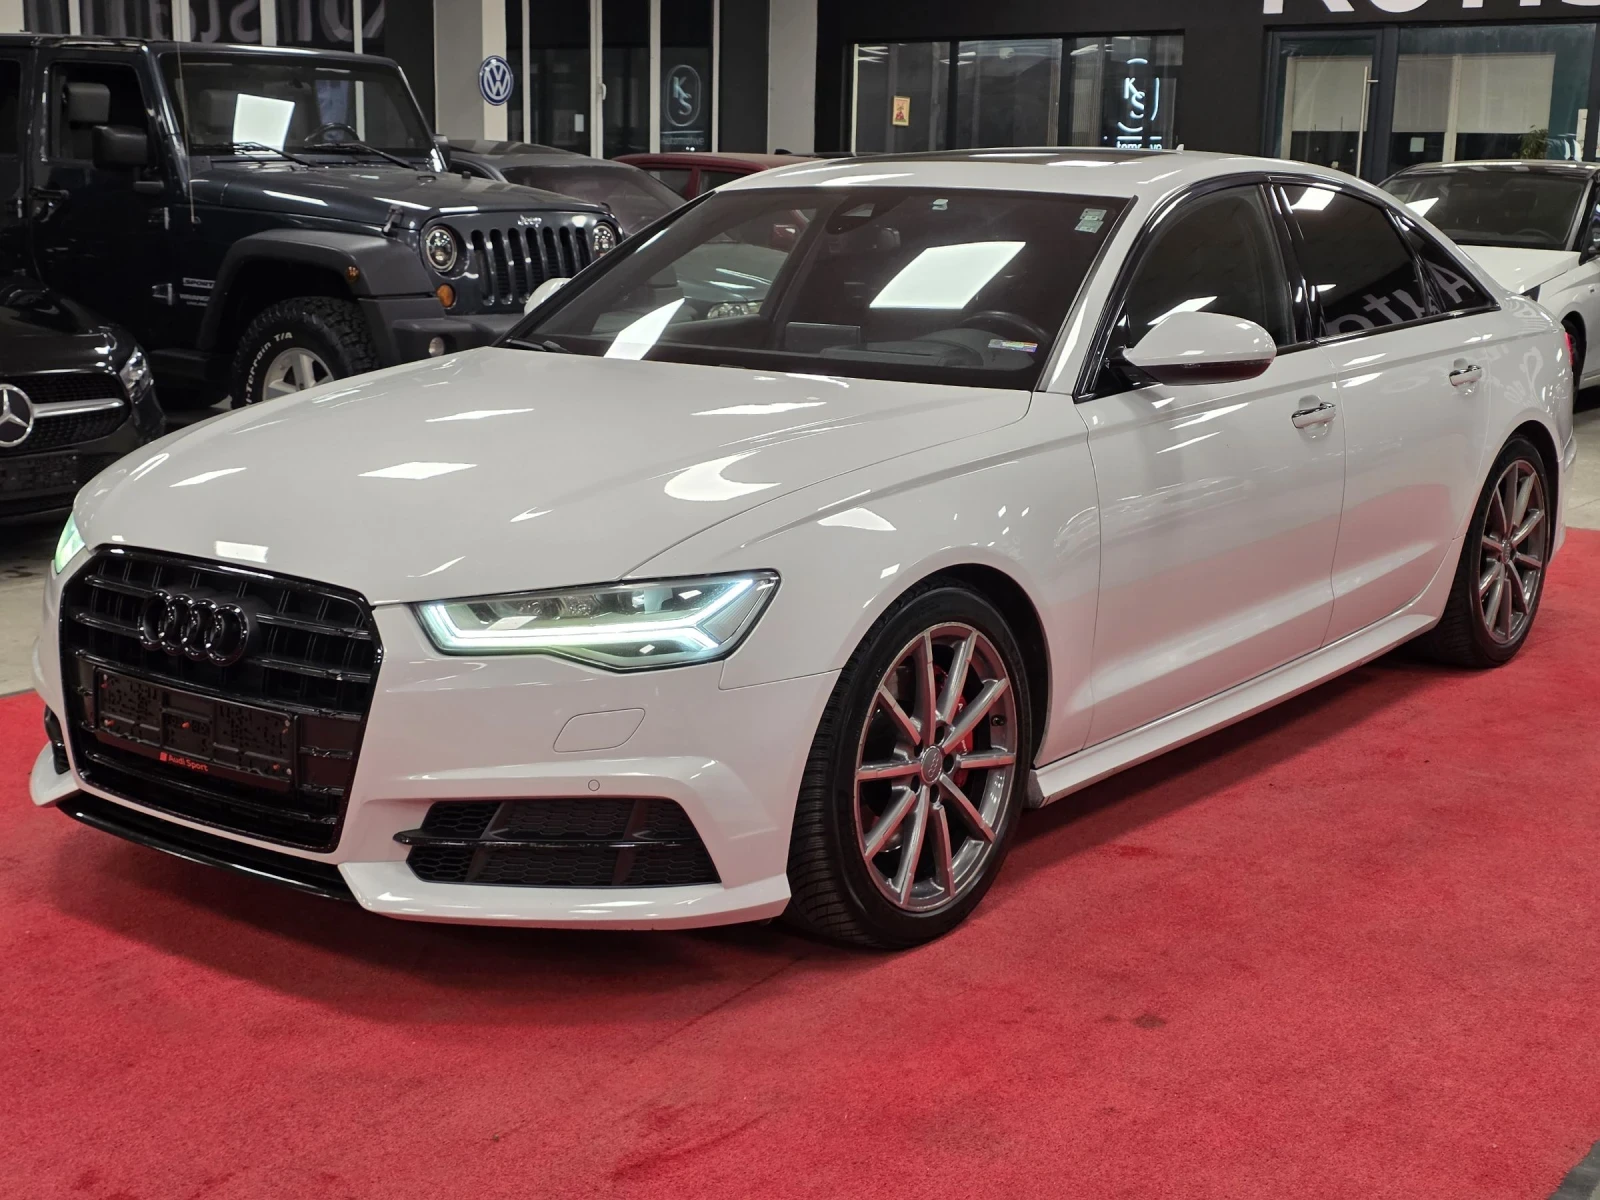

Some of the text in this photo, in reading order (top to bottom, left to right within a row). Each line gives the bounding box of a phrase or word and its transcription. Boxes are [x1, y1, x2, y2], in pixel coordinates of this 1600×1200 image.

[274, 331, 293, 342] T/A
[169, 754, 208, 772] Audi Sport
